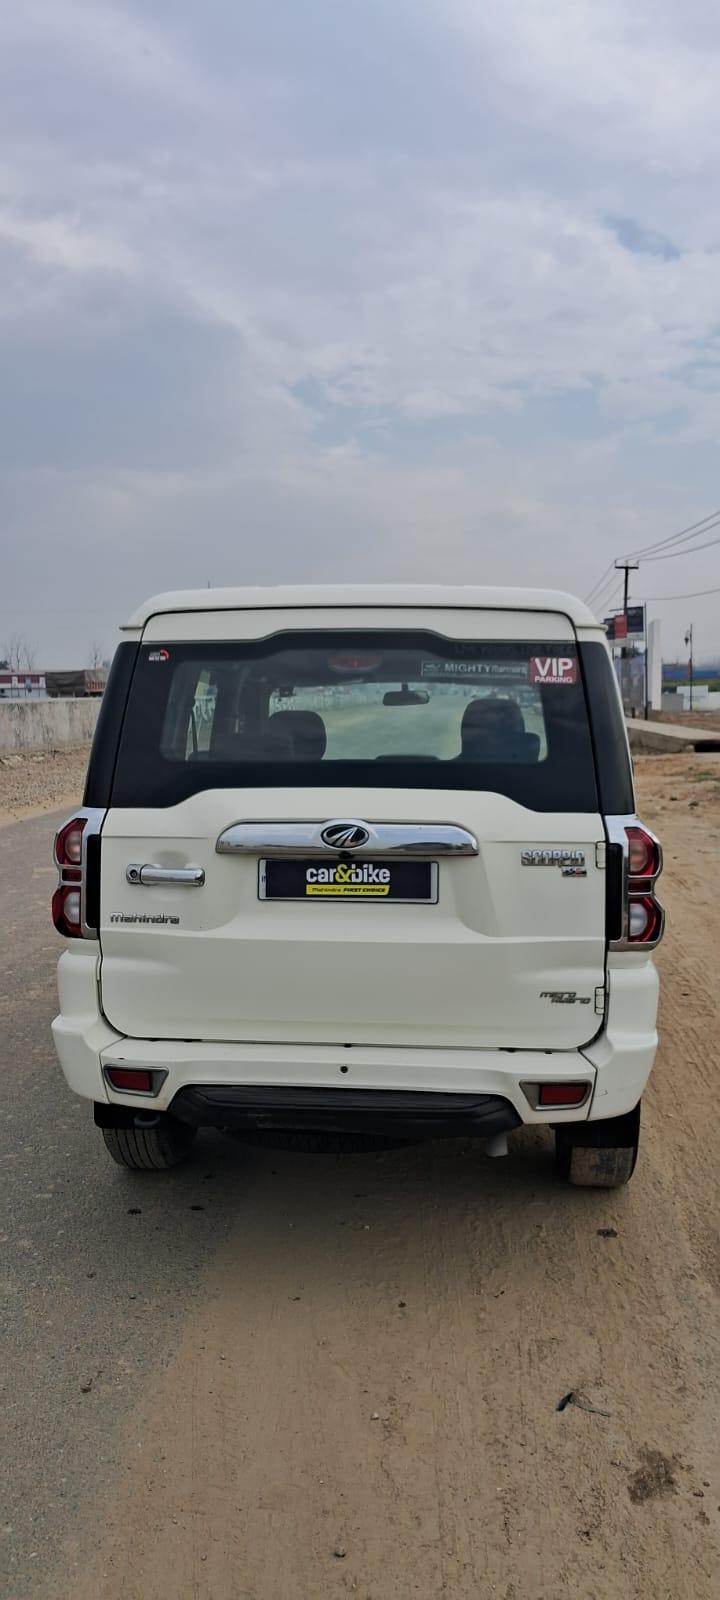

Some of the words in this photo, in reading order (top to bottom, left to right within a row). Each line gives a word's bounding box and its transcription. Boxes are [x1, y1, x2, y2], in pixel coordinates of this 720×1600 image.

[444, 663, 490, 673] MIGHTY
[534, 657, 574, 677] VIP
[534, 676, 573, 684] PARKING
[521, 848, 585, 867] SCORPIO
[305, 863, 391, 883] car&bike
